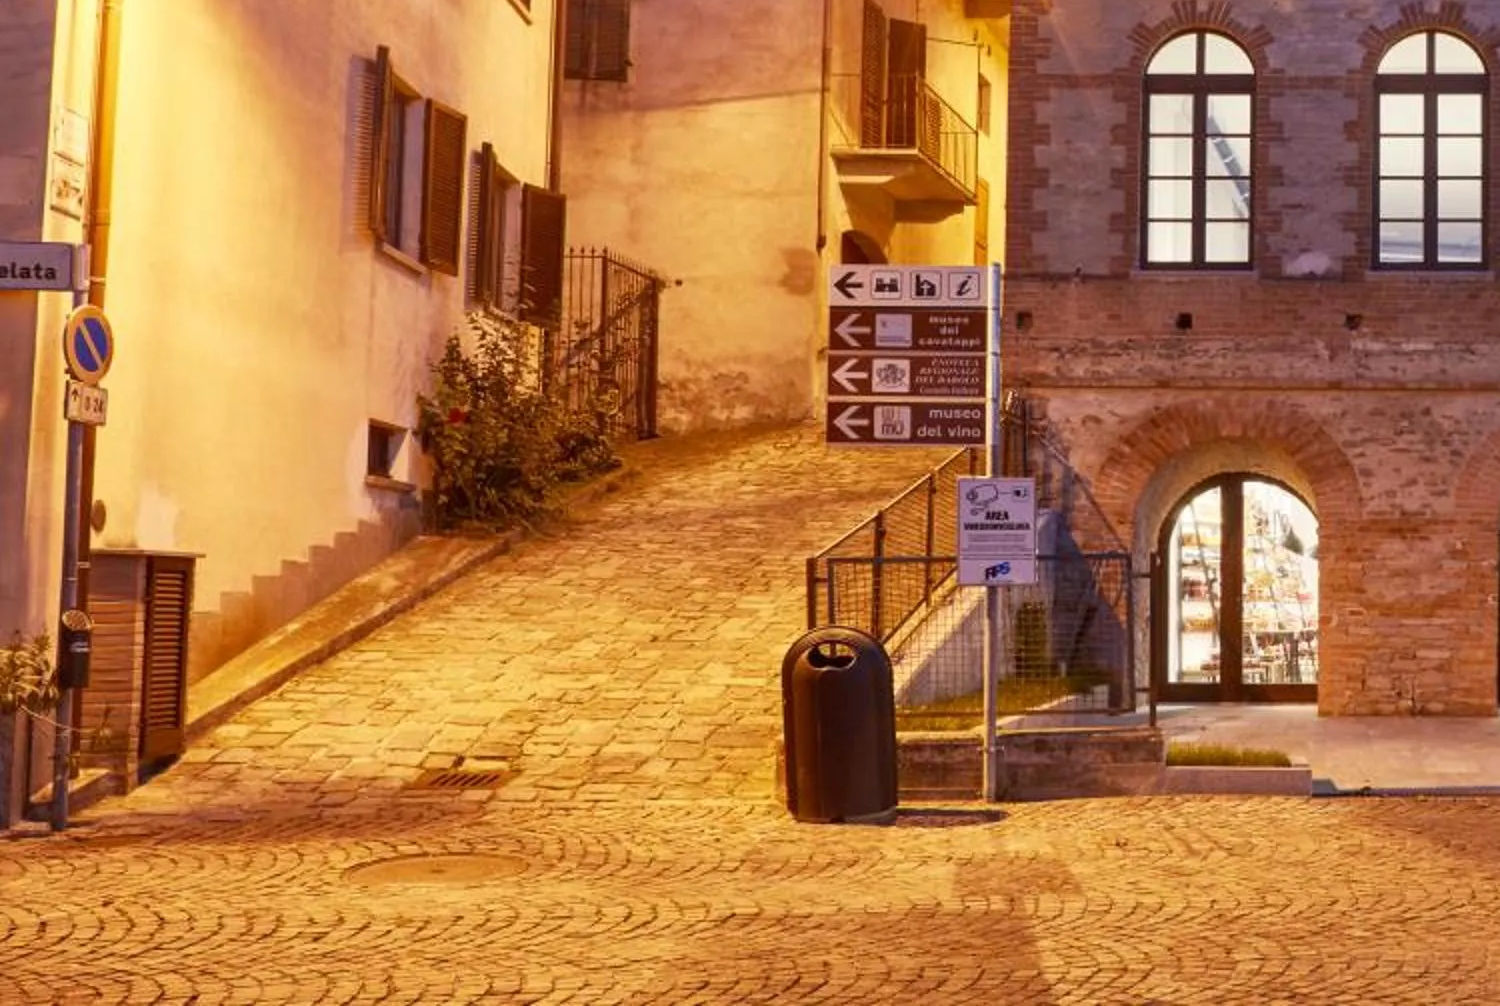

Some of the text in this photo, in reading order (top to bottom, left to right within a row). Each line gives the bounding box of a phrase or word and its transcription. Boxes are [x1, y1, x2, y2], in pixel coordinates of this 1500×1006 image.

[928, 408, 981, 419] museo
[916, 425, 981, 438] del vino
